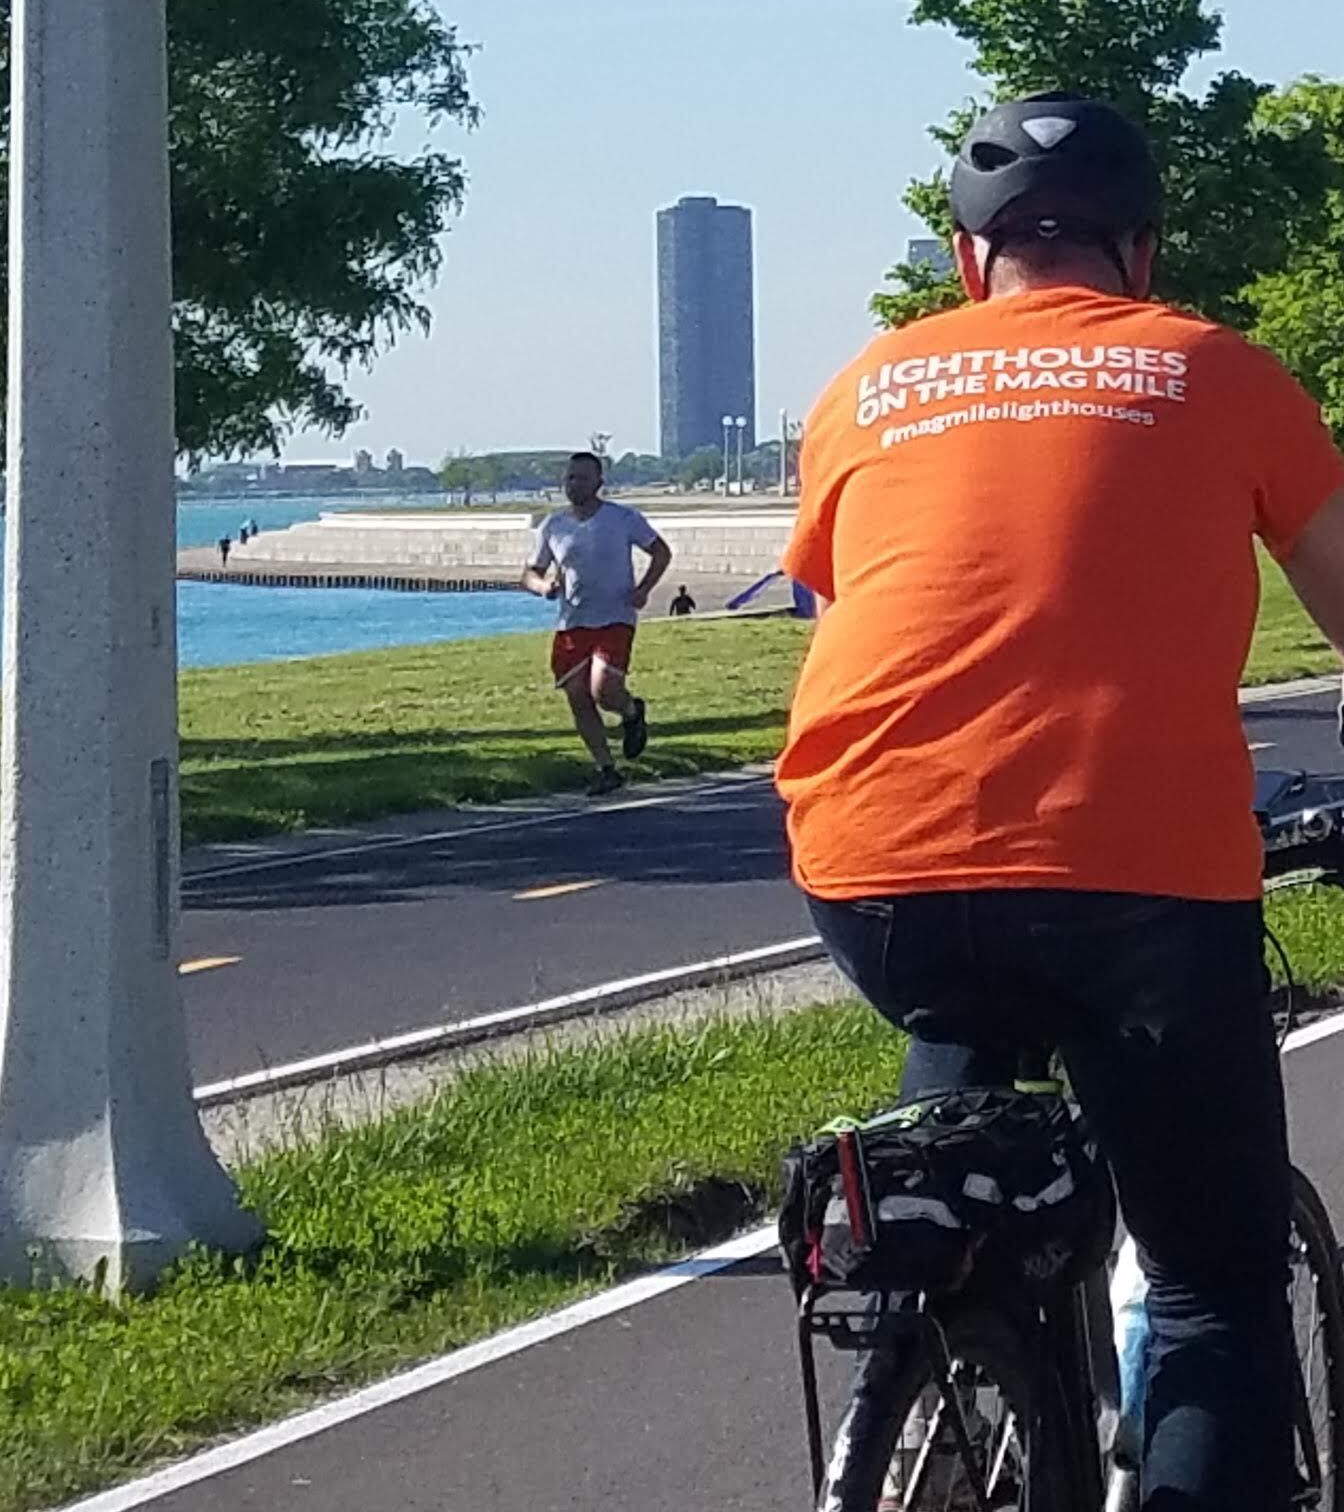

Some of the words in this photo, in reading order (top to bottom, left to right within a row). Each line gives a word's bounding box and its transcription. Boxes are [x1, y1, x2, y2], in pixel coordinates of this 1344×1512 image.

[855, 387, 907, 427] ON
[914, 374, 986, 405] THE
[994, 370, 1089, 392] MAG
[1096, 371, 1187, 402] MILE
[858, 345, 1187, 402] LIGHTHOUSES
[880, 399, 1155, 448] #magmilelighthouses
